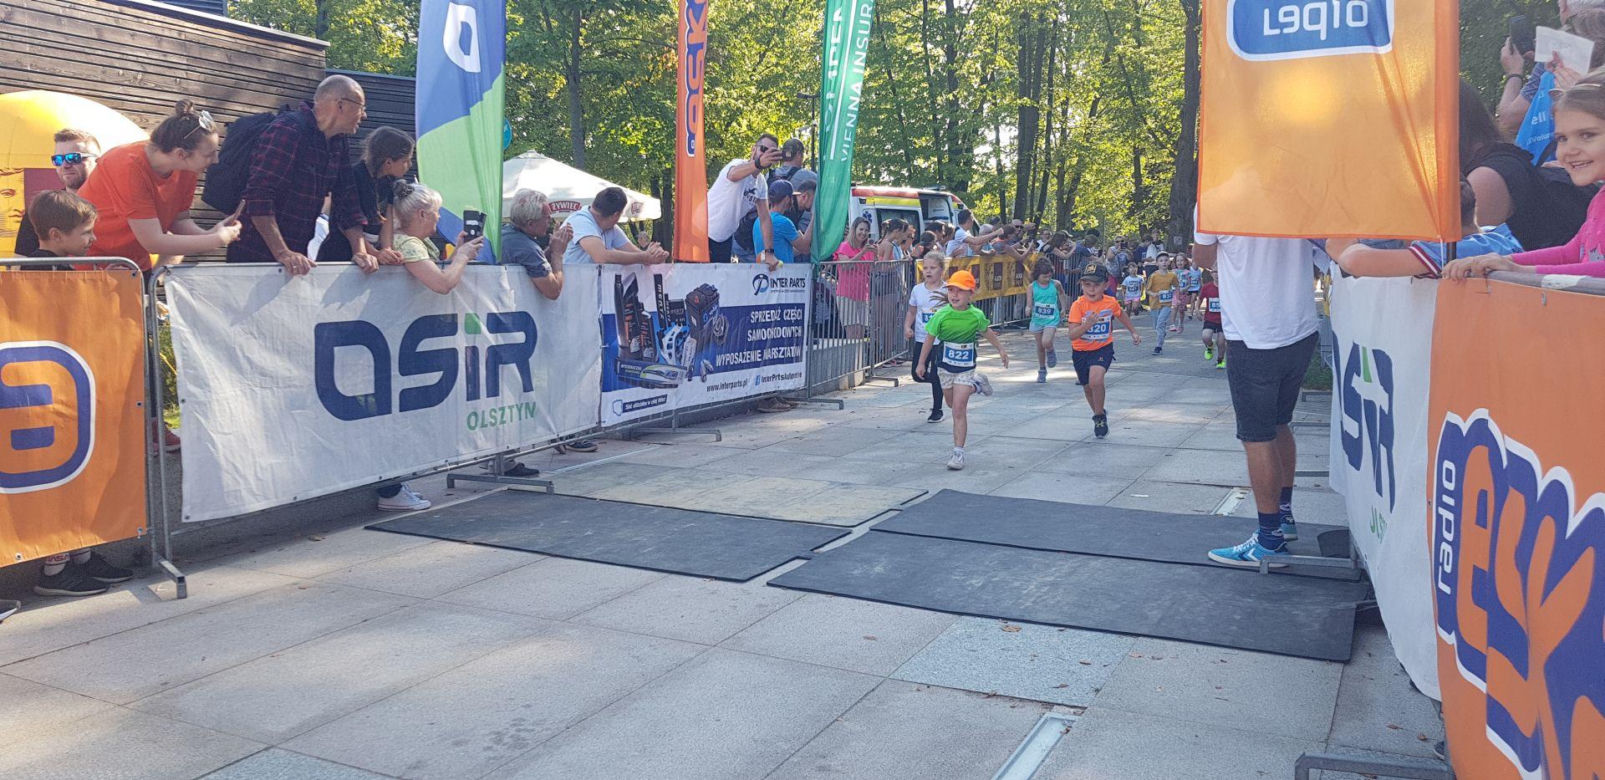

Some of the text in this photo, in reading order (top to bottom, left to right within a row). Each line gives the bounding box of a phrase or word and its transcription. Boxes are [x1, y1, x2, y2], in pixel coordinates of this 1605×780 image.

[841, 0, 874, 162] VIENNA INSUR
[770, 277, 806, 289] INTER PARTS
[948, 350, 969, 360] 822
[466, 401, 537, 431] OLSZTYN
[1437, 458, 1456, 595] radio
